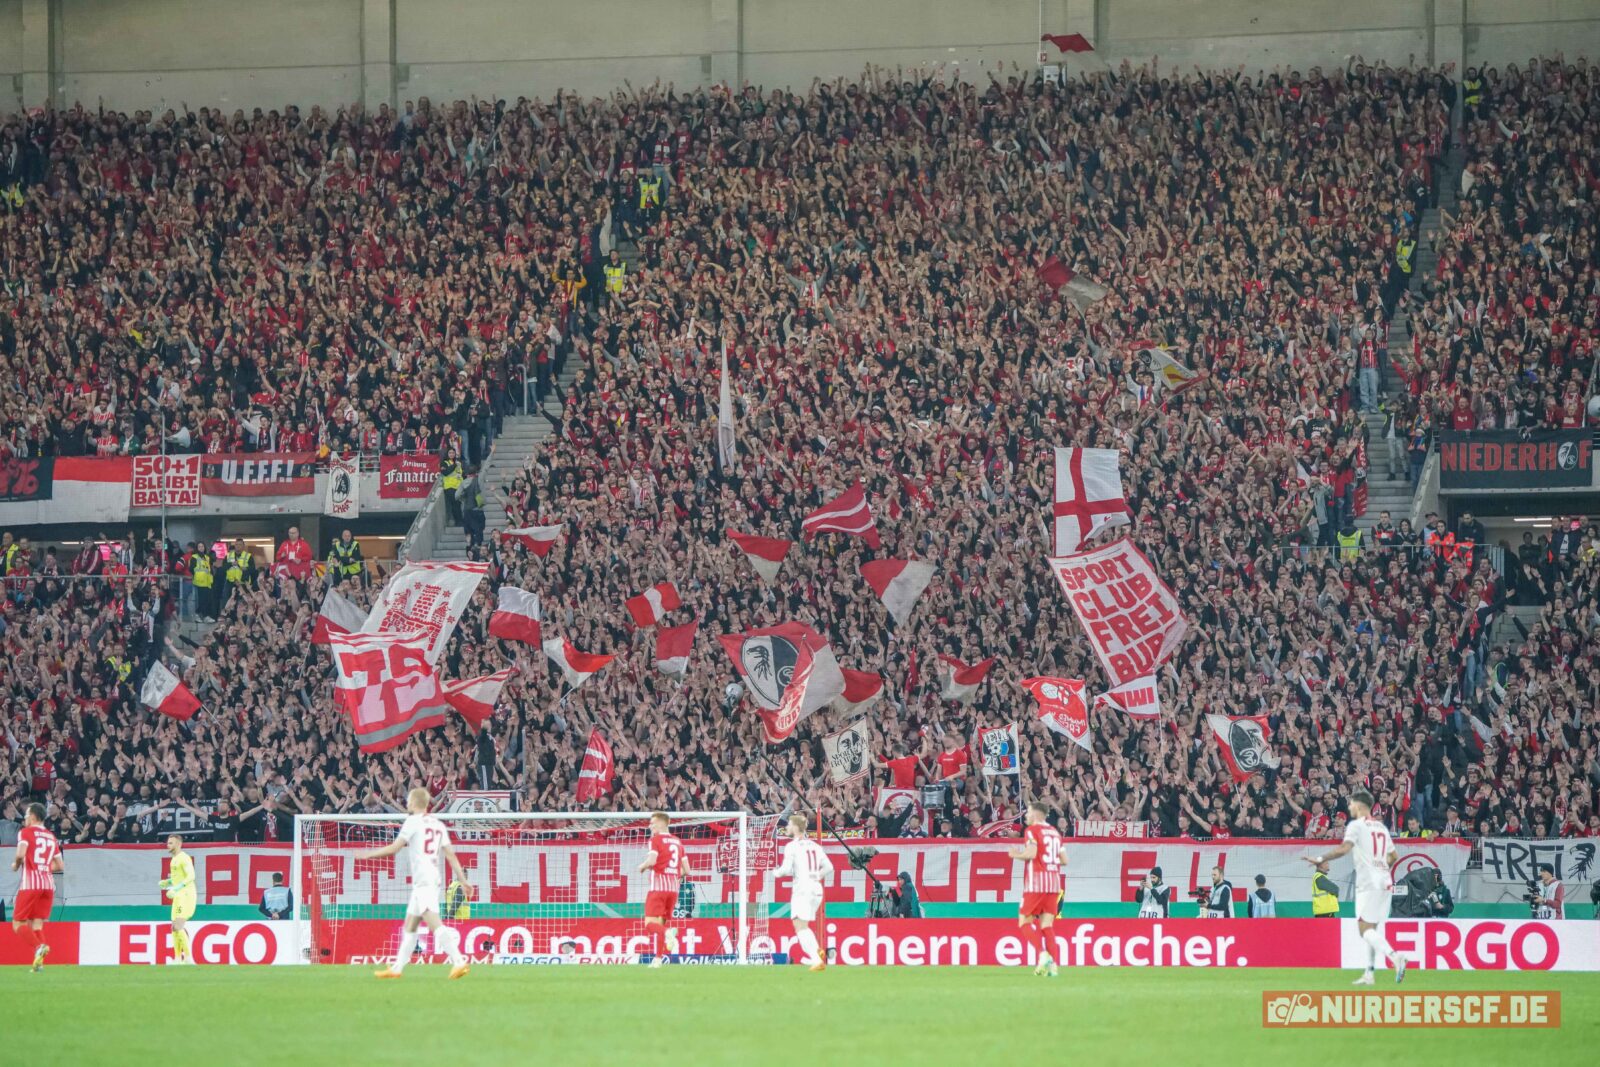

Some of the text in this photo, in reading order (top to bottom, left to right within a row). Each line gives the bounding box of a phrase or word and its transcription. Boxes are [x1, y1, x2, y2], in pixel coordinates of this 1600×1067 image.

[135, 455, 200, 476] 50+1
[221, 459, 295, 485] U.F.F.F.!
[134, 475, 199, 490] BLEIBT.
[134, 490, 198, 505] BASTA!
[1060, 552, 1134, 590] SPORT
[1073, 573, 1153, 620] CLUB
[1090, 592, 1175, 654] FREI
[33, 837, 56, 865] 27
[424, 828, 444, 854] 27
[1042, 835, 1061, 865] 30
[1370, 831, 1387, 858] 17
[668, 844, 679, 868] 3
[805, 849, 818, 872] 11
[1483, 841, 1565, 881] FREI
[119, 923, 278, 965] ERGO
[995, 923, 1249, 967] einfacher.
[1385, 920, 1561, 971] ERGO
[351, 954, 489, 965] FLYEALARM
[678, 955, 774, 966] Volkswgen
